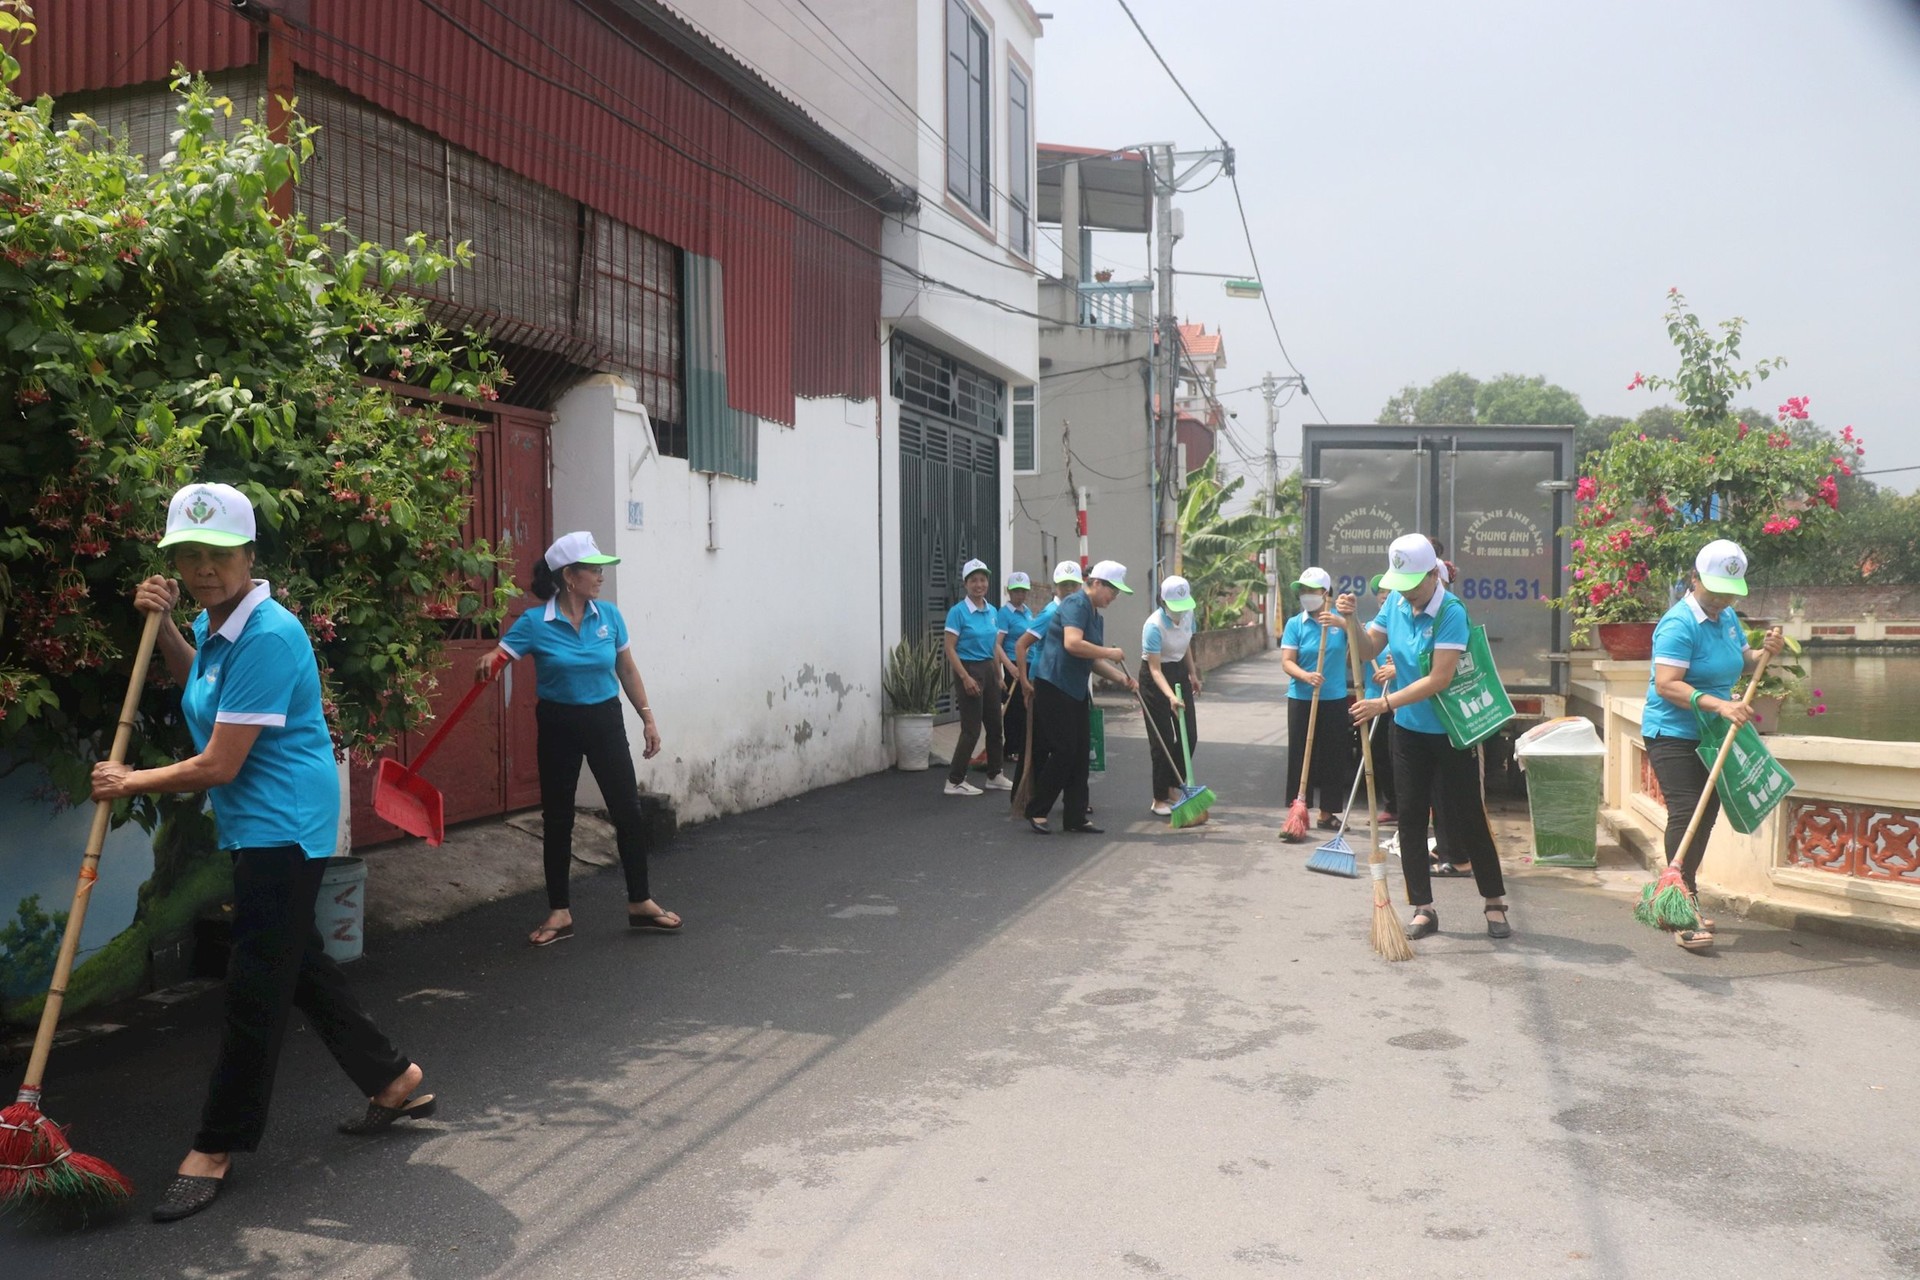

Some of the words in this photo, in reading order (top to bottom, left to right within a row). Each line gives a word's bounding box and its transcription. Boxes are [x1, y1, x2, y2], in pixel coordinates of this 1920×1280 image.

[1340, 529, 1370, 540] CHUNG
[1475, 531, 1507, 542] CHUNG
[1463, 578, 1541, 600] 868.31
